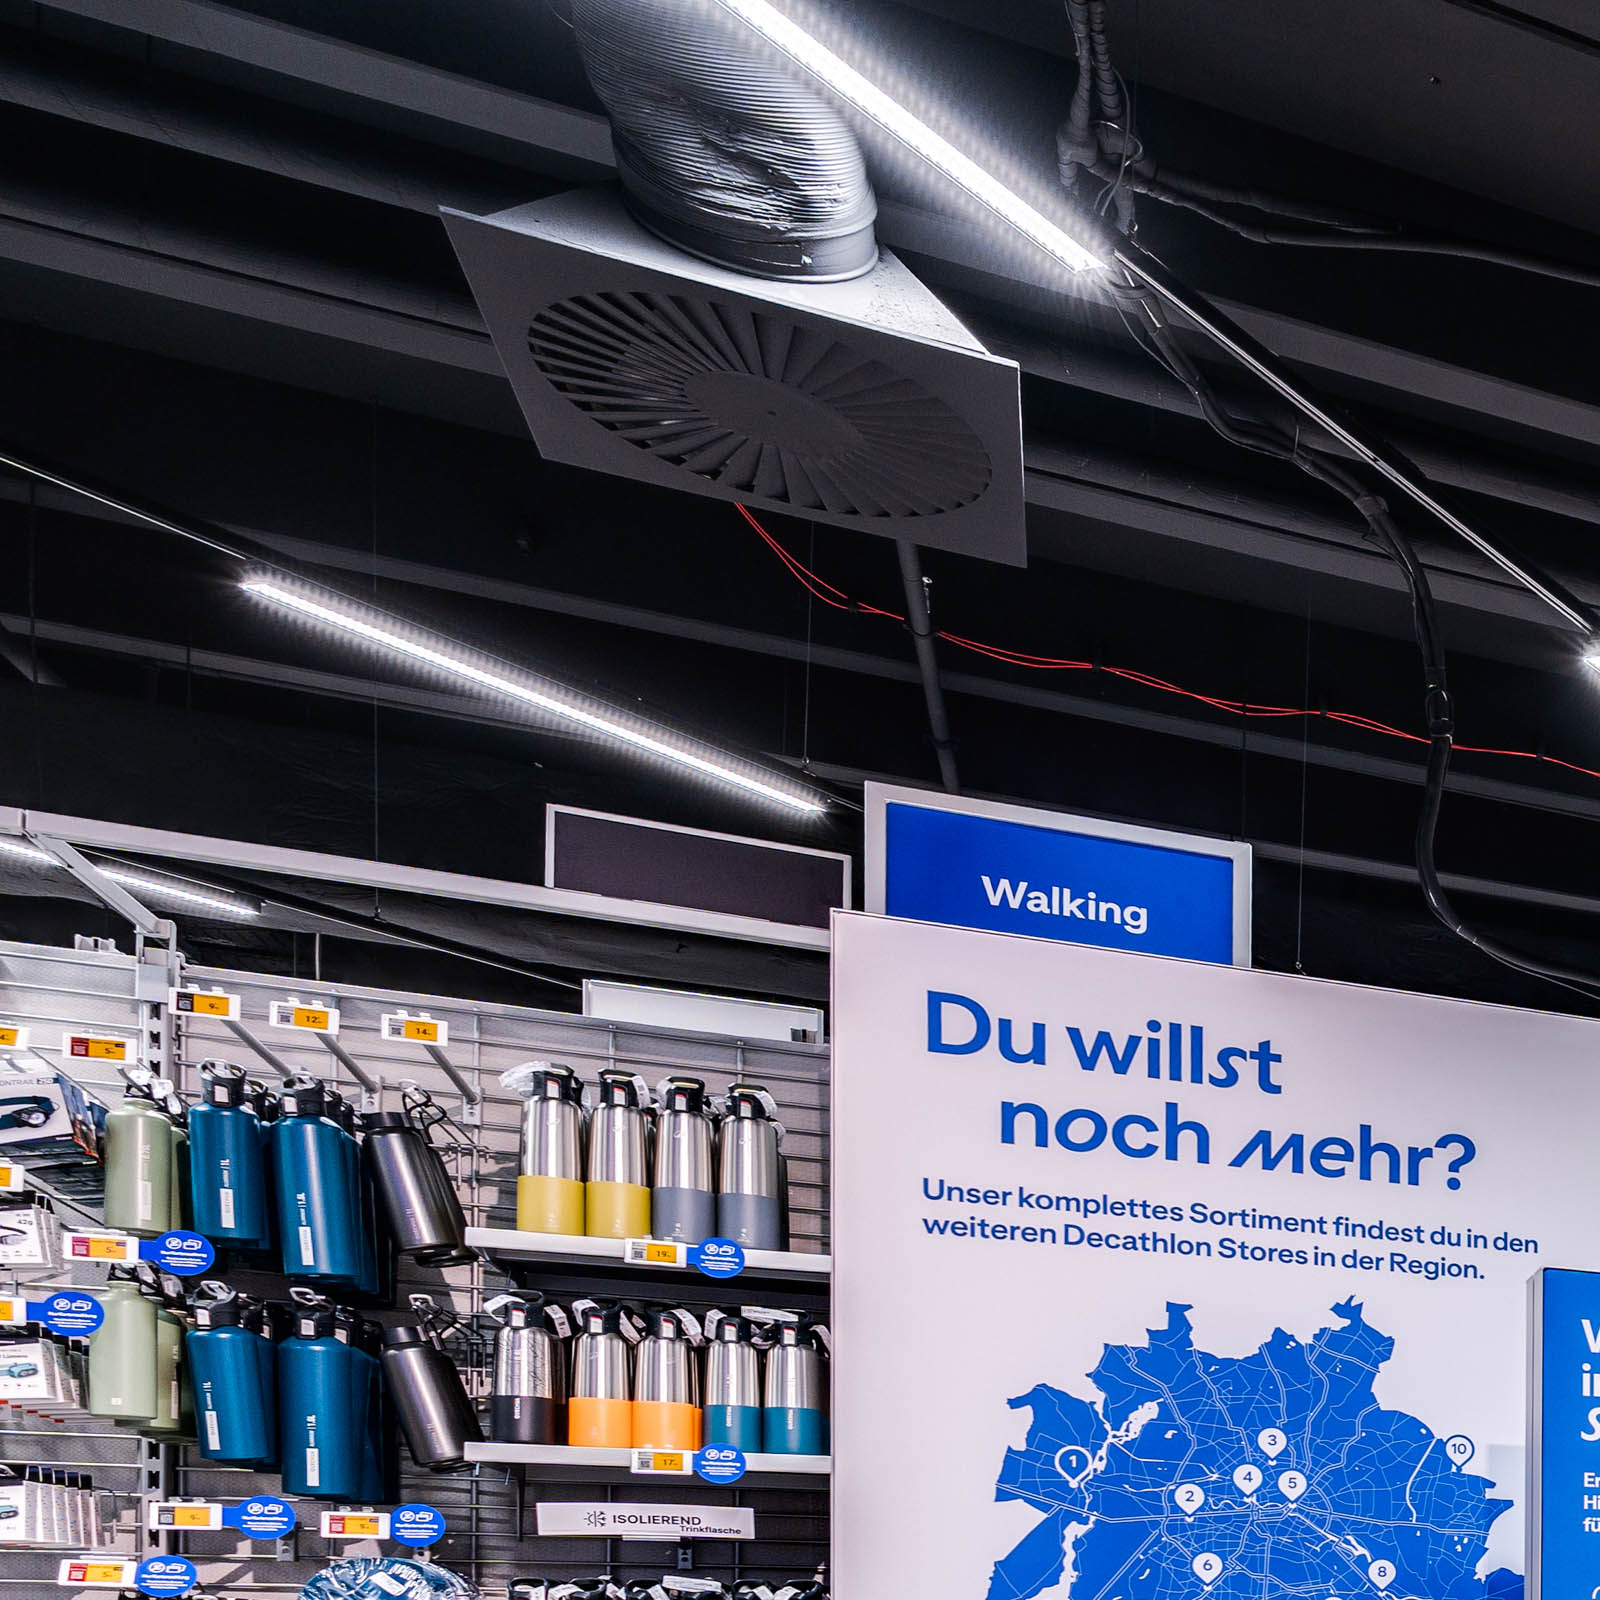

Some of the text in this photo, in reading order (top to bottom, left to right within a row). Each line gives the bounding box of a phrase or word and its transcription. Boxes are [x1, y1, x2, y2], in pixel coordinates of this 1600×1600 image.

[981, 875, 1148, 935] Walking
[927, 990, 1282, 1095] Du willst
[1000, 1101, 1477, 1191] noch mehr?
[922, 1177, 1539, 1254] Unser komplettes Sortiment findest du in den
[921, 1218, 1485, 1281] weiteren Decathlon Stores in der Region.
[1267, 1434, 1278, 1447] 3
[1447, 1438, 1470, 1455] 10
[1068, 1454, 1079, 1470] 1
[1242, 1471, 1254, 1483] 4
[1288, 1477, 1297, 1489] 5
[1184, 1490, 1195, 1503] 2
[612, 1514, 702, 1526] ISOLIEREND
[679, 1525, 742, 1535] Trinkflasche
[1202, 1559, 1213, 1572] 6
[1377, 1565, 1388, 1578] 8
